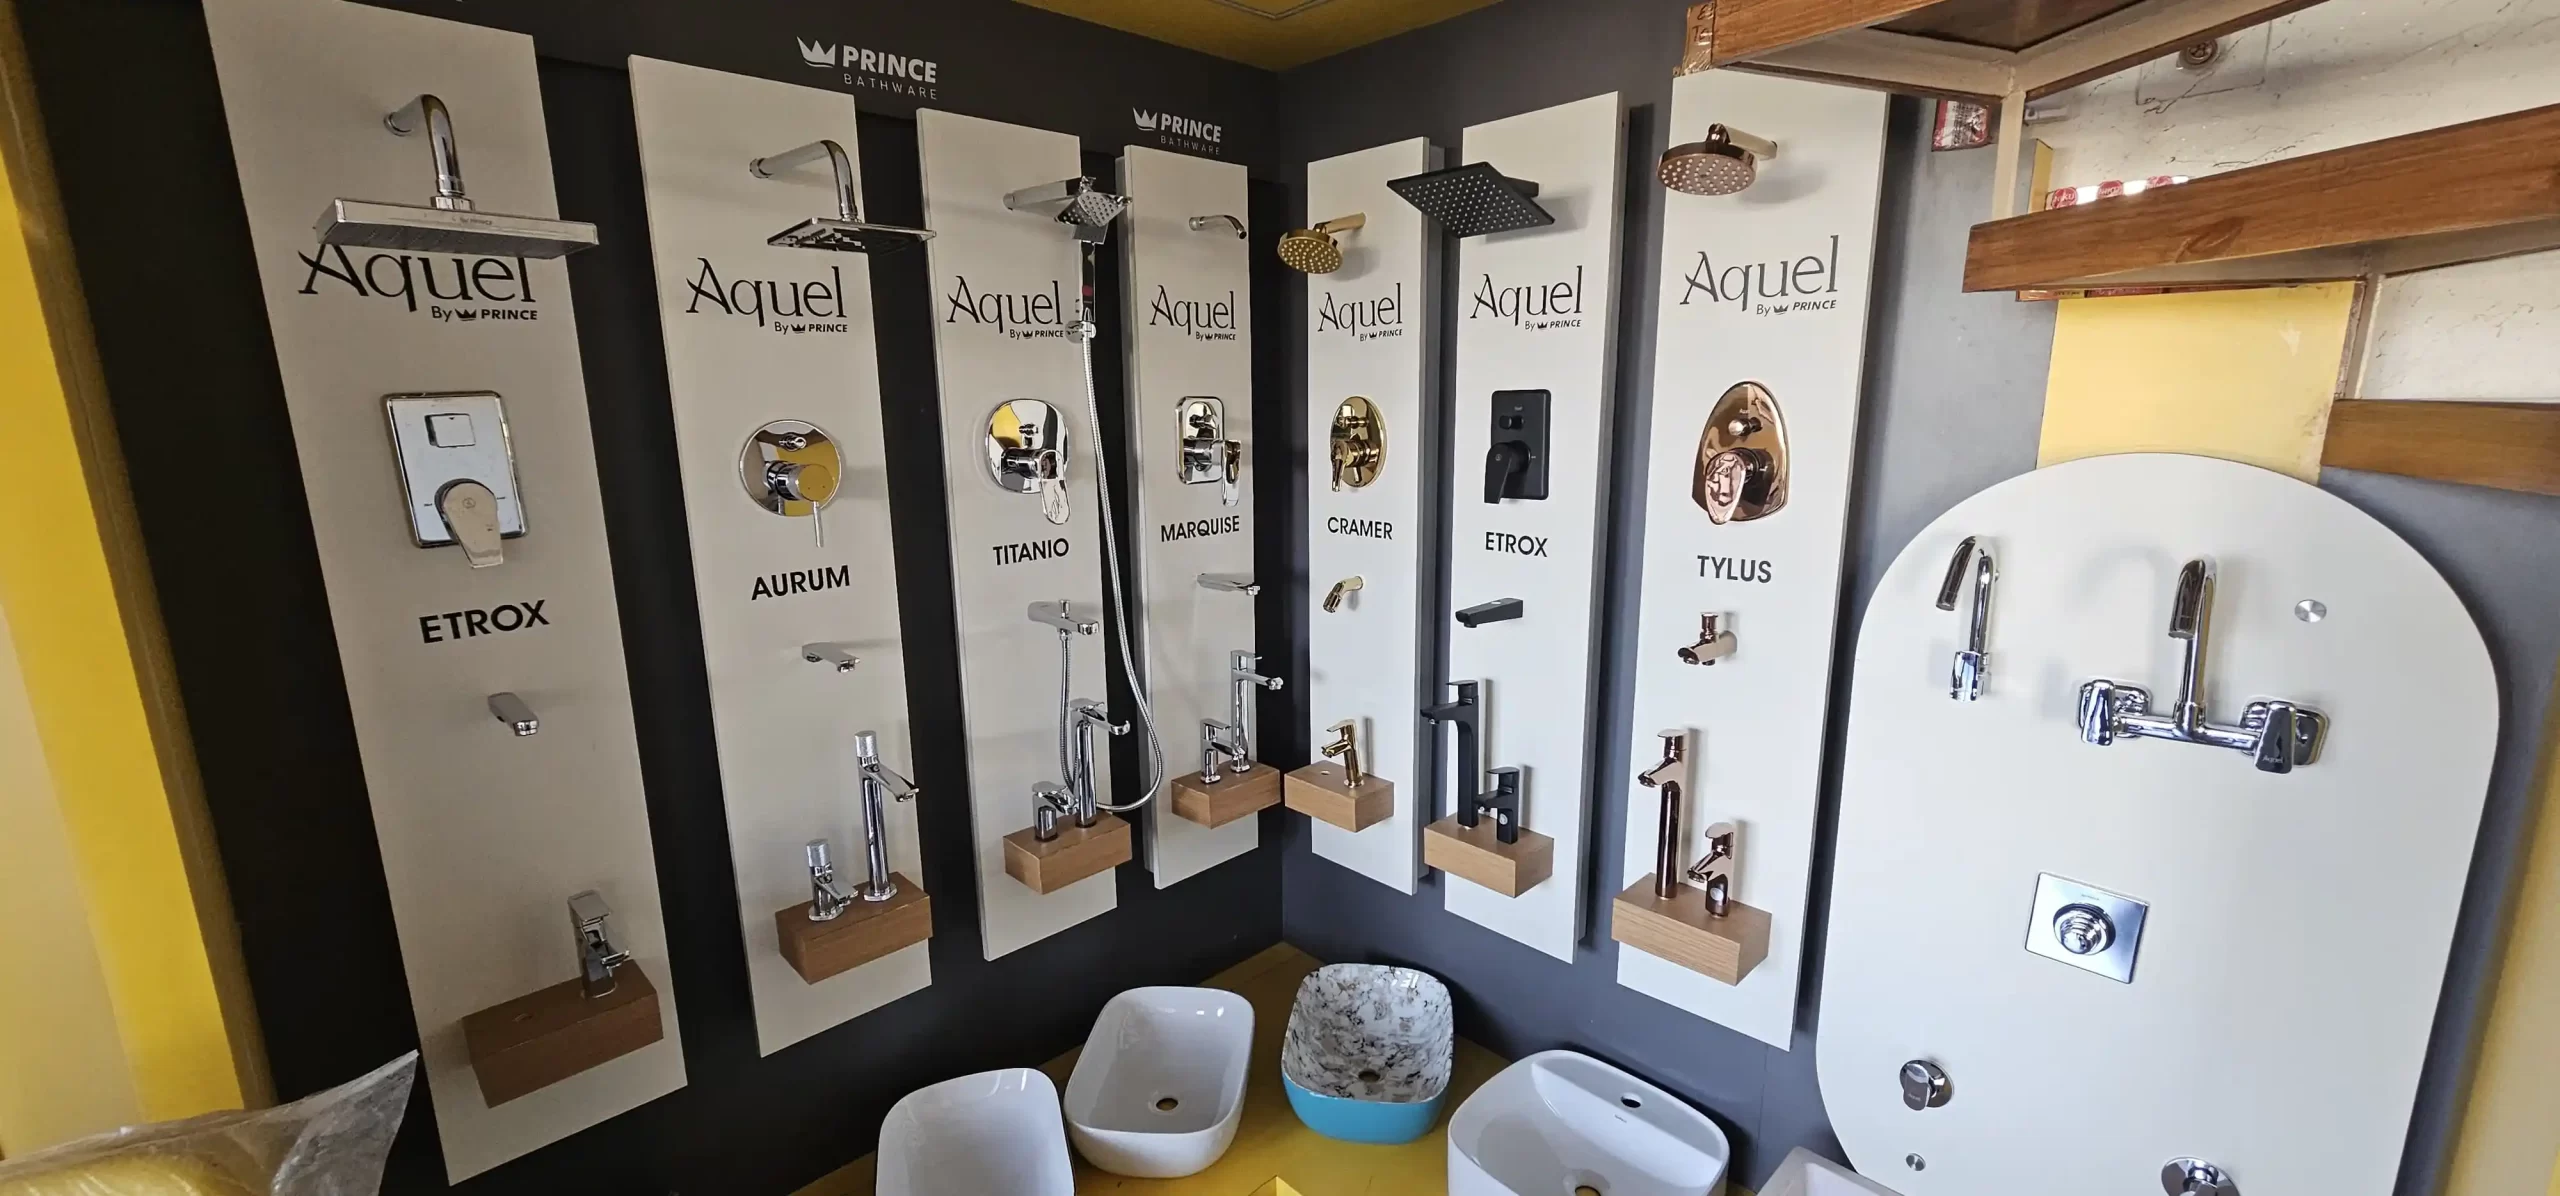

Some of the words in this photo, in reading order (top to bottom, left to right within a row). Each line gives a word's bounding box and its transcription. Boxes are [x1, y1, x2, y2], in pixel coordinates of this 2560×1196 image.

[843, 45, 937, 83] PRINCE
[843, 73, 937, 100] BATHWARE
[1160, 113, 1222, 142] PRINCE
[1160, 135, 1220, 155] BATHWARE
[298, 244, 536, 312] Aquel
[1680, 235, 1838, 311] Aquel
[686, 258, 847, 328] Aquel
[947, 275, 1063, 334] Aquel
[1469, 265, 1583, 326] Aquel
[431, 305, 453, 322] By
[481, 309, 538, 321] PRINCE
[1149, 285, 1236, 336] Aquel
[1317, 282, 1402, 336] Aquel
[1756, 303, 1771, 317] By
[1792, 299, 1838, 311] PRINCE
[775, 322, 789, 334] By
[808, 323, 848, 333] PRINCE
[1009, 329, 1021, 340] By
[1034, 330, 1064, 338] PRINCE
[1195, 331, 1205, 342] By
[1214, 333, 1236, 341] PRINCE
[1378, 328, 1403, 338] PRINCE
[1524, 320, 1536, 332] By
[1549, 319, 1582, 329] PRINCE
[1160, 516, 1240, 542] MARQUISE
[1327, 517, 1393, 540] CRAMER
[993, 538, 1069, 566] TITANIO
[1485, 532, 1548, 558] ETROX
[751, 565, 850, 600] AURUM
[1697, 555, 1772, 584] TYLUS
[419, 599, 550, 643] ETROX
